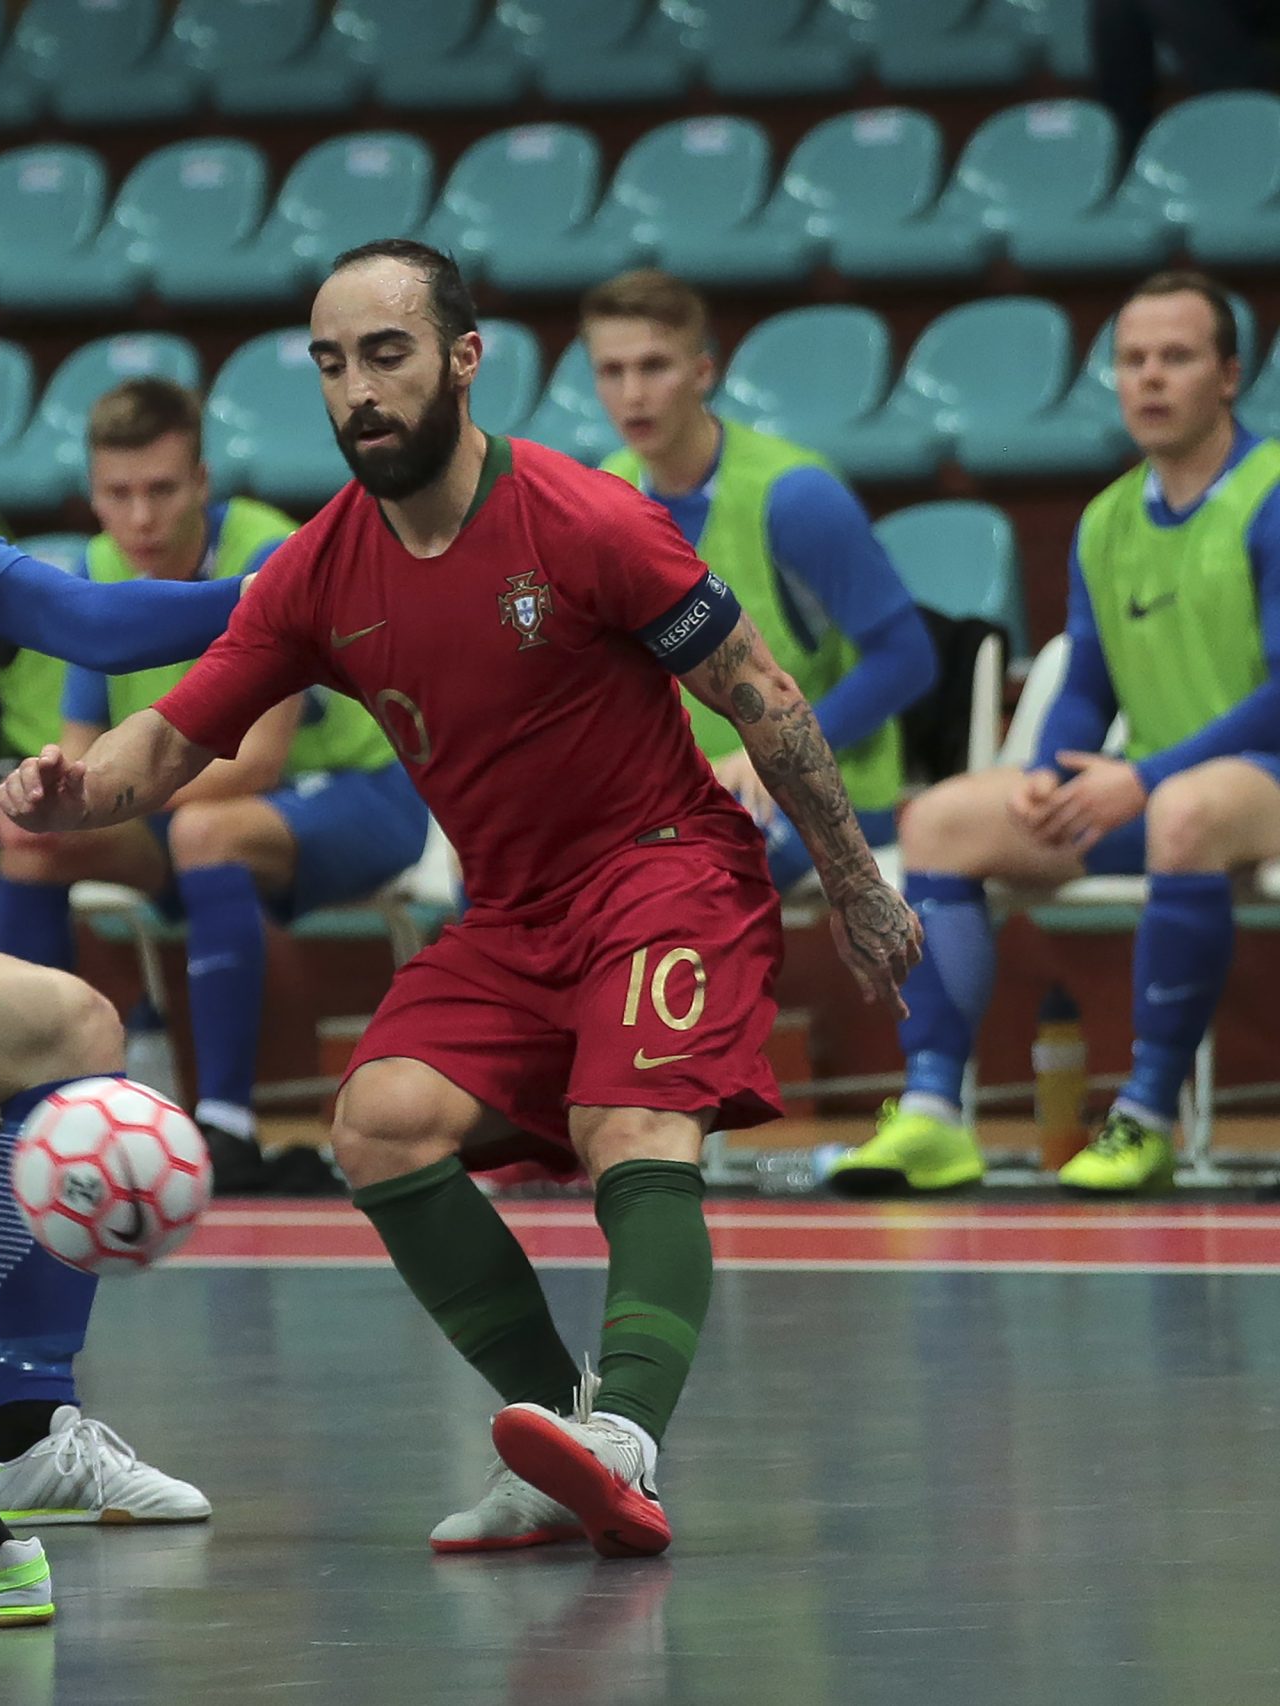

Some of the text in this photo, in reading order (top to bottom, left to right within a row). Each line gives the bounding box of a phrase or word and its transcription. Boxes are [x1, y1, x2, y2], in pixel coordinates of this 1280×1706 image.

[660, 600, 711, 649] RESPECT
[375, 688, 432, 765] 0
[622, 947, 706, 1031] 10
